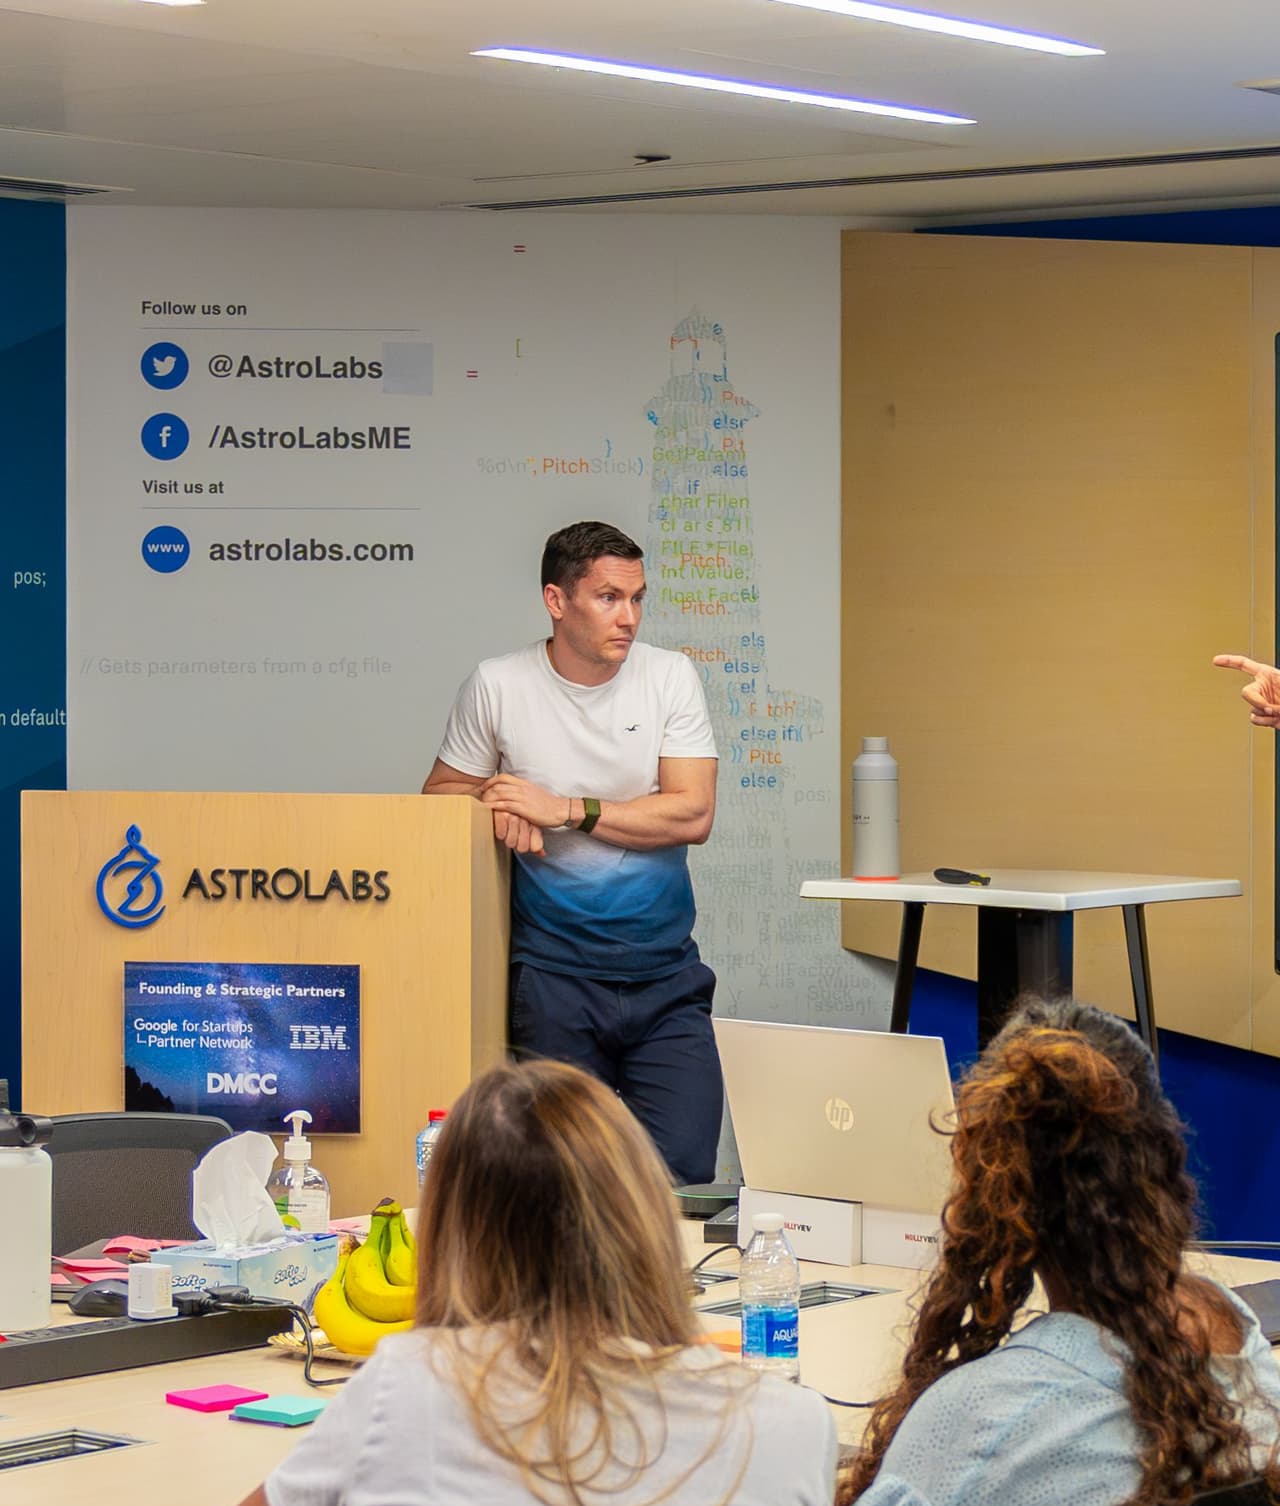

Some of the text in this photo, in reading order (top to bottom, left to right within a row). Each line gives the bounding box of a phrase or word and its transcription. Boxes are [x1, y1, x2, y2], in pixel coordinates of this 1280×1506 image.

[141, 300, 247, 316] Follow us on
[208, 354, 383, 379] @AstroLabs
[208, 425, 411, 449] /AstroLabsME
[142, 479, 224, 494] Visit us at
[147, 543, 185, 553] www
[208, 538, 414, 561] astrolabs.com
[13, 568, 47, 588] pos;
[10, 708, 66, 727] default
[182, 867, 391, 901] ASTROLABS
[139, 982, 346, 1000] Founding & Strategic Partners
[133, 1018, 253, 1036] Google for Startups
[148, 1035, 253, 1049] Partner Network
[289, 1025, 347, 1050] IBM
[206, 1072, 277, 1095] DMCC
[827, 1098, 852, 1131] hp
